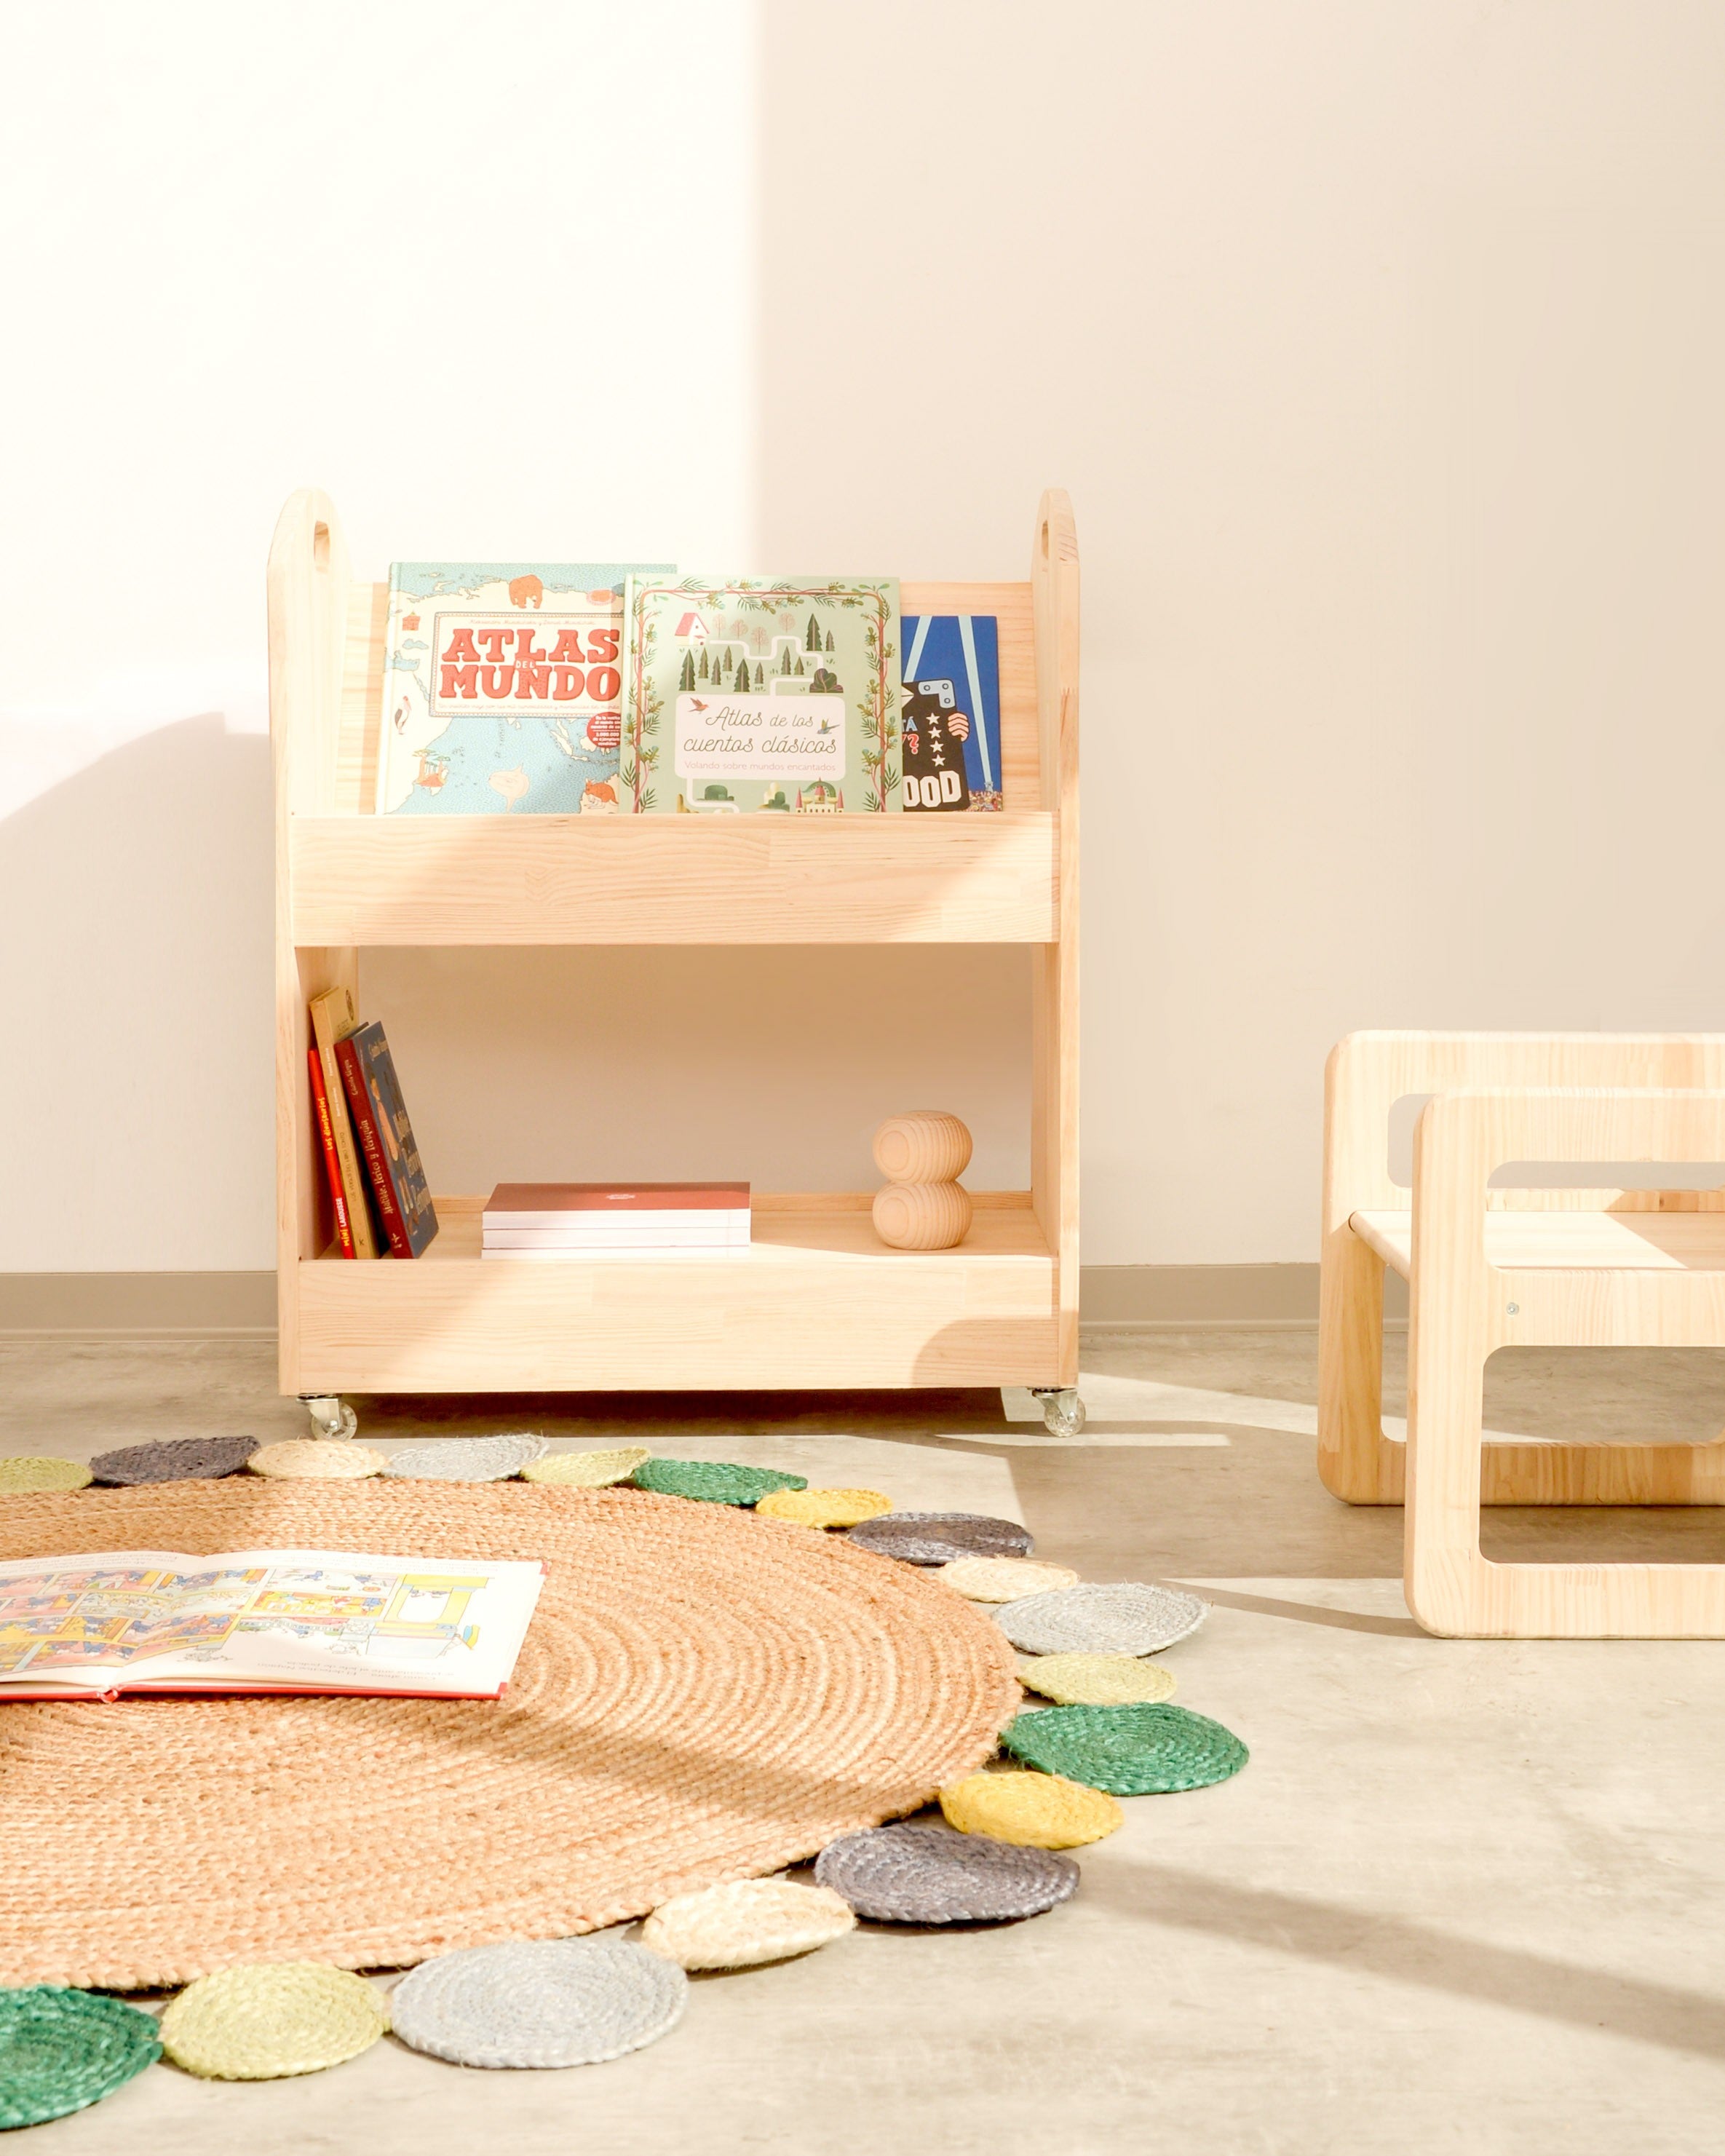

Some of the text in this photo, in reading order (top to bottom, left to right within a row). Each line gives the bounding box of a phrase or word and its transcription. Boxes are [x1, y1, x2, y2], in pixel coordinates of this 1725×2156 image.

[442, 629, 619, 663] ATLAS
[515, 658, 535, 669] DEL
[439, 665, 621, 701] MUNDO
[705, 706, 814, 731] Atlas de los
[683, 735, 837, 754] cuentos clásicos
[684, 761, 836, 772] Volando sobre mundos encantados
